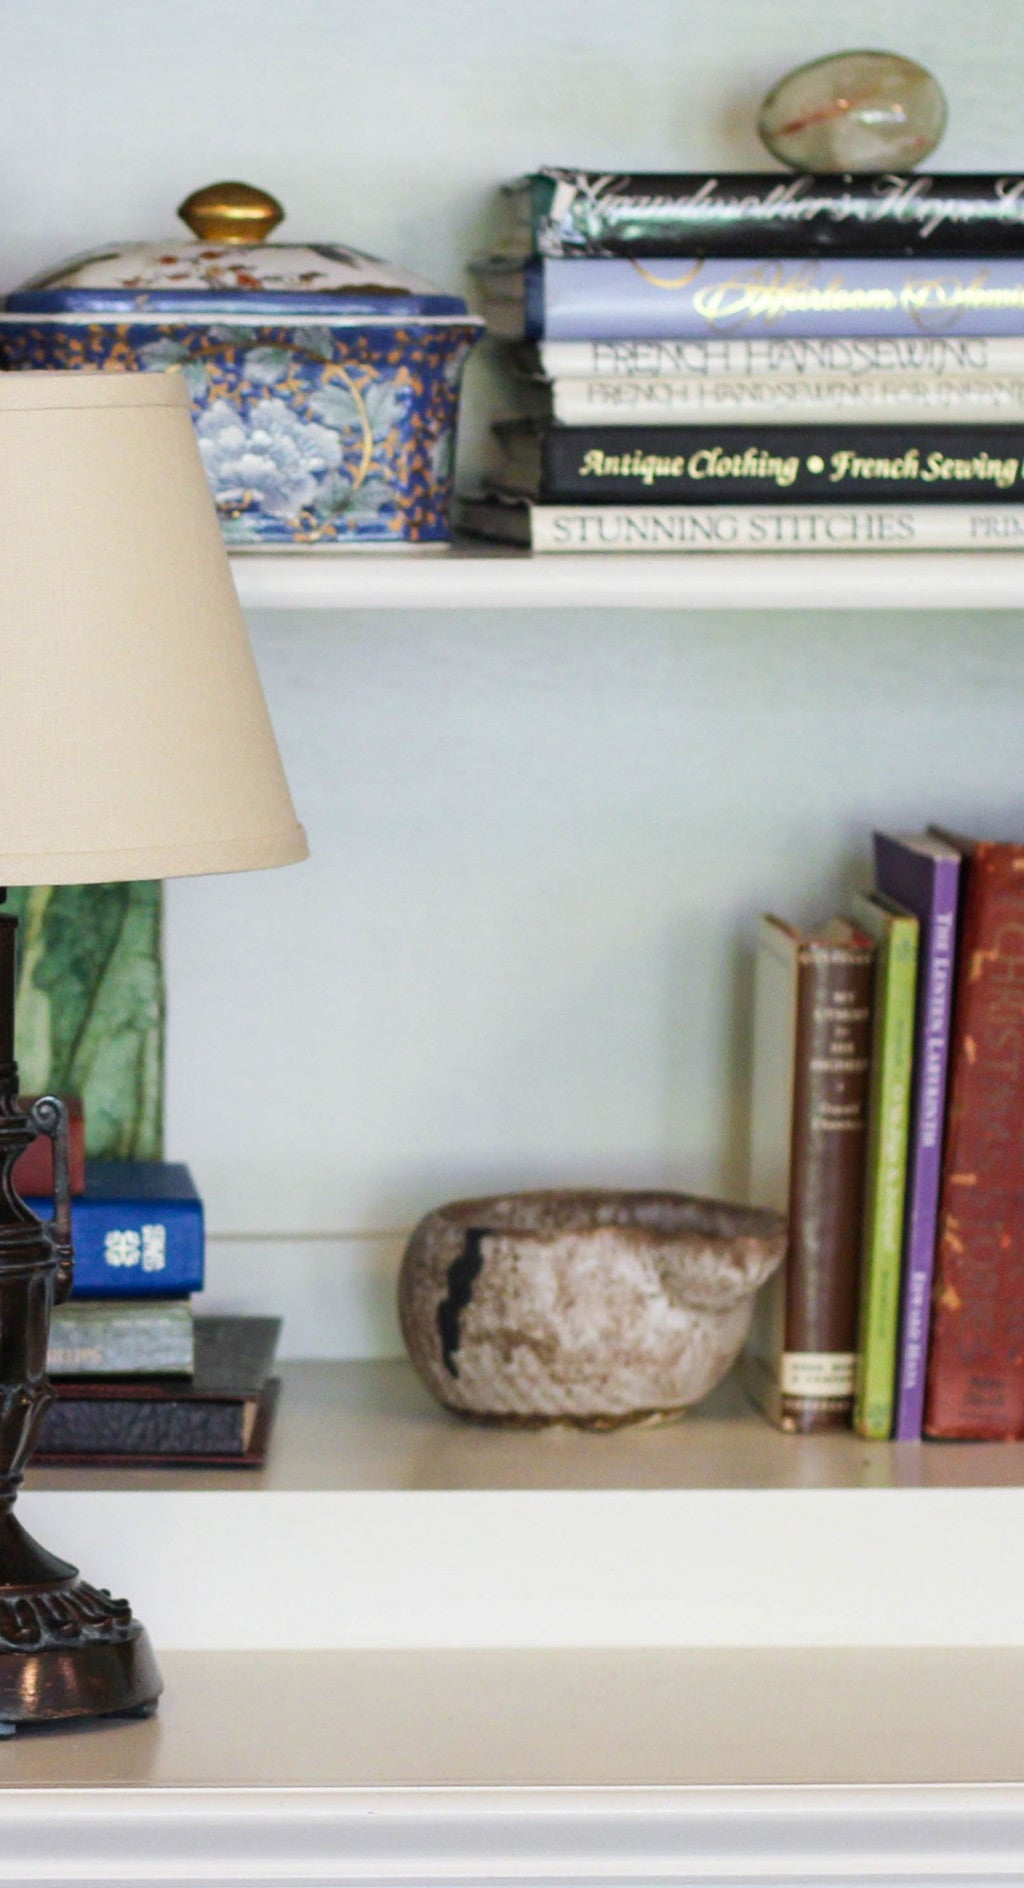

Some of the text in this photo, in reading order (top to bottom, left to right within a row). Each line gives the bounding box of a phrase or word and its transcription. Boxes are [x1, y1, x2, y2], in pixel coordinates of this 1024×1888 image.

[591, 340, 989, 377] FRENCH HANDSEWING
[587, 381, 689, 405] FRENCH
[578, 447, 1020, 489] Antique Clothing French Sewing
[552, 513, 739, 542] STUNNING
[748, 512, 916, 542] STITCHES
[933, 911, 954, 952] THE
